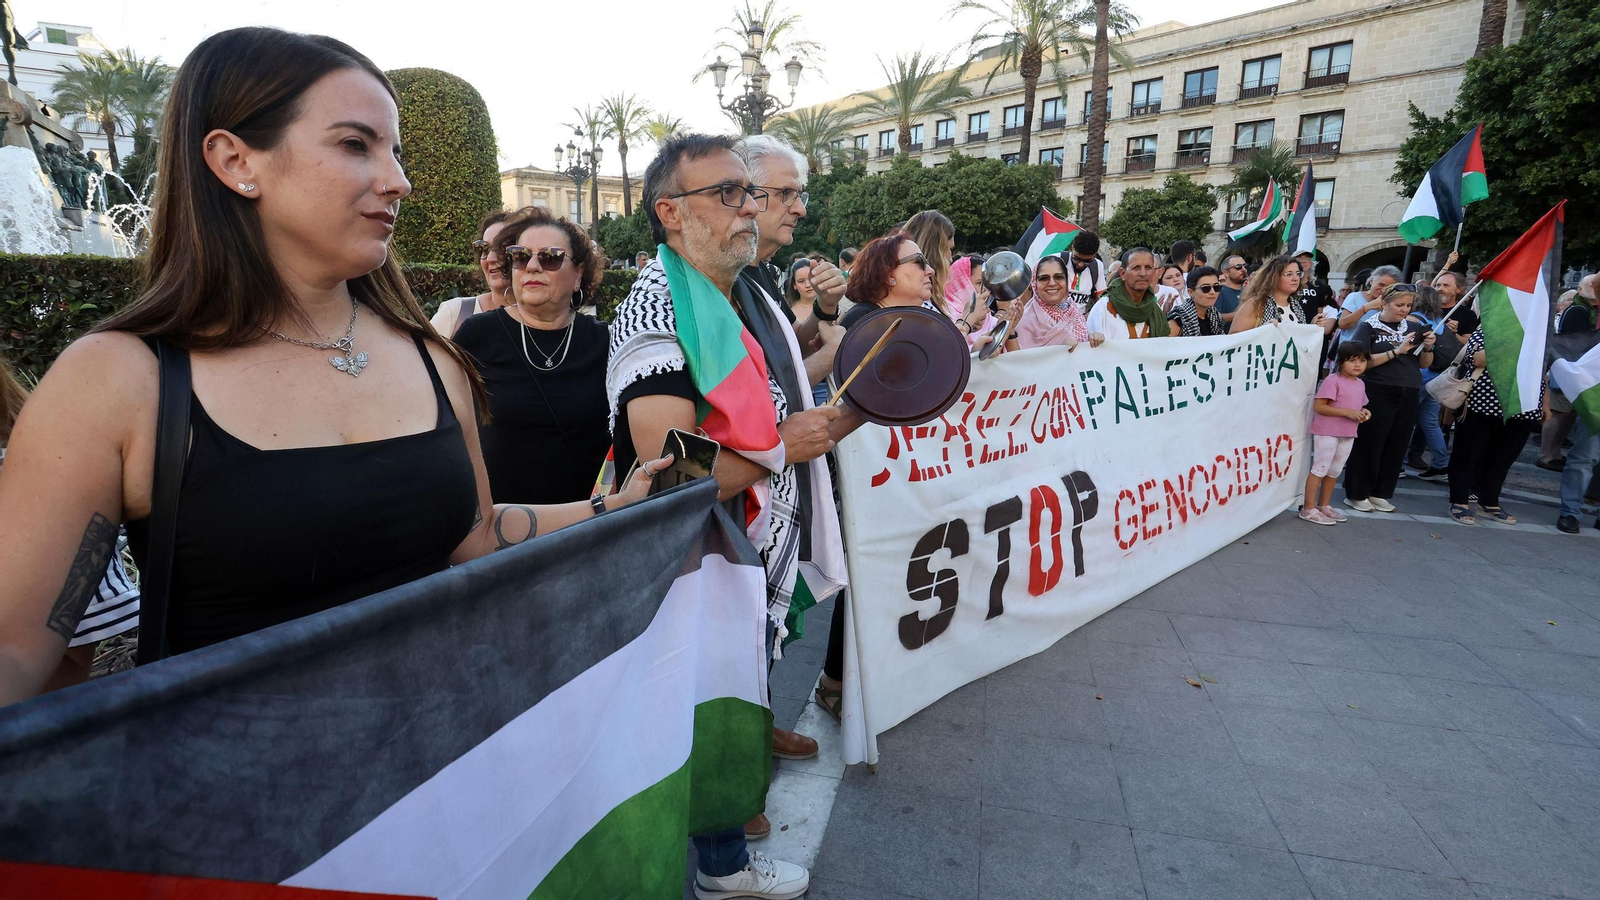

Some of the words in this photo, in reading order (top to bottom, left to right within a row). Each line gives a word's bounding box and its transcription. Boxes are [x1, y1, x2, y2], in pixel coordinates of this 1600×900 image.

[1031, 384, 1085, 444] CON
[1079, 338, 1300, 430] PALESTINA
[898, 470, 1099, 651] STOP
[1114, 434, 1293, 550] GENOCIDIO
